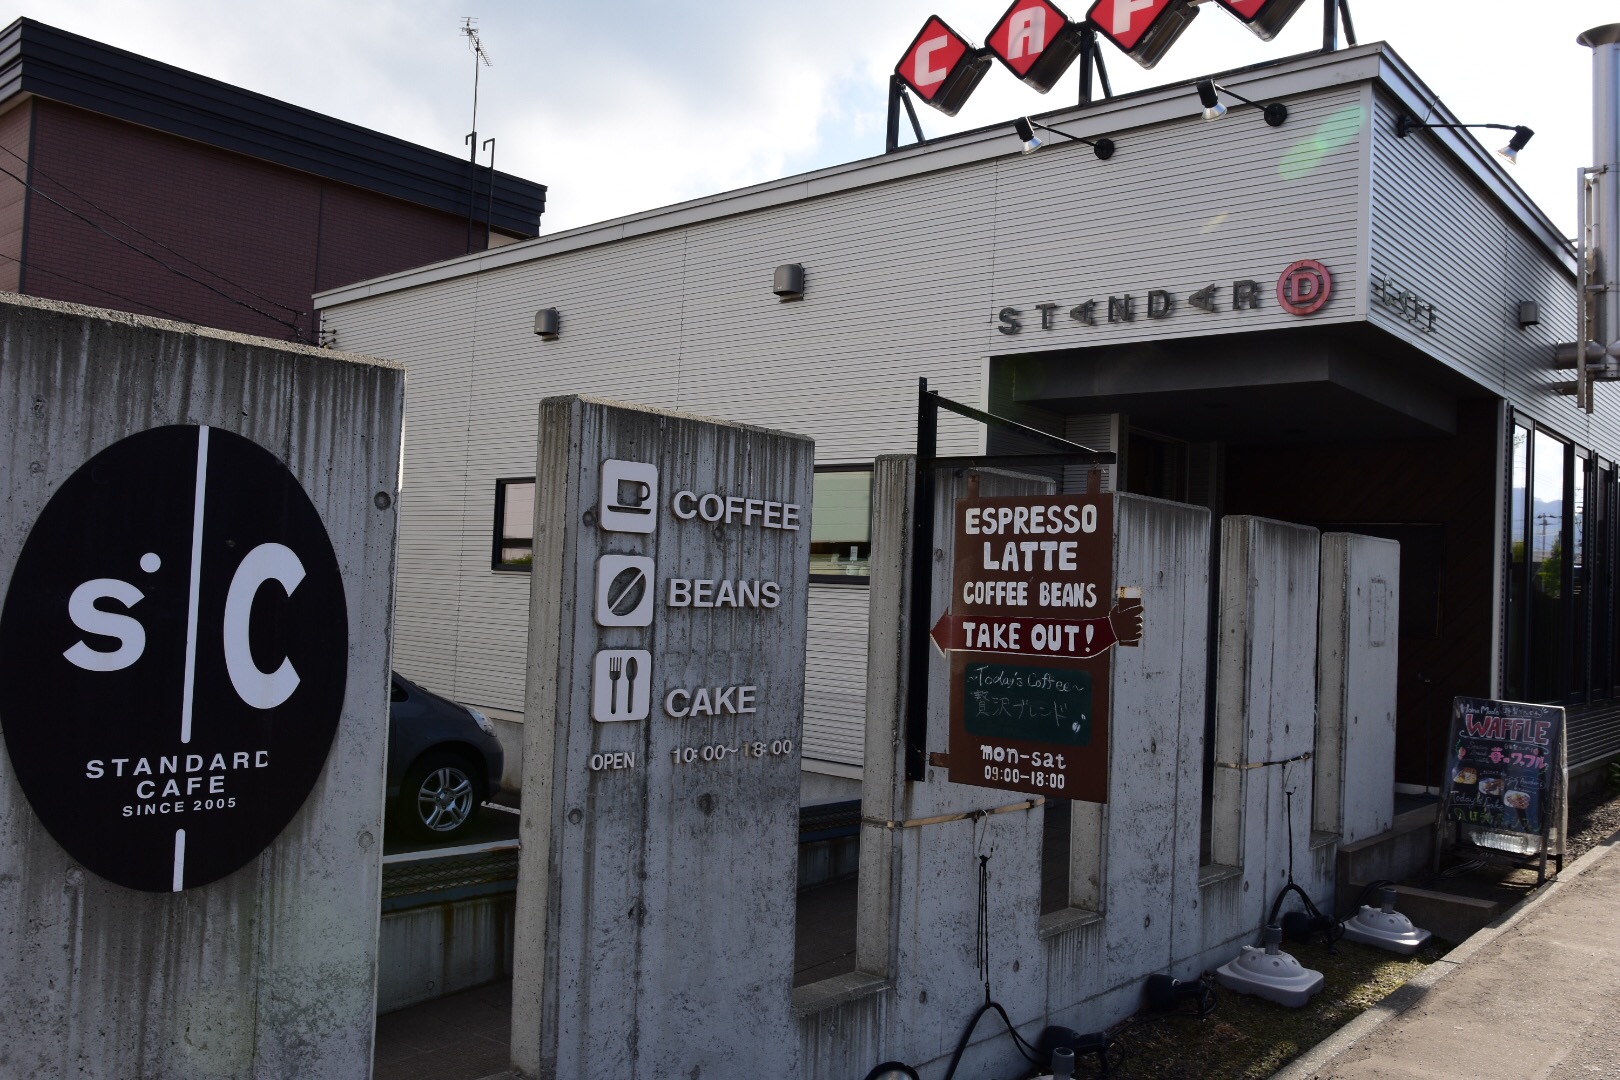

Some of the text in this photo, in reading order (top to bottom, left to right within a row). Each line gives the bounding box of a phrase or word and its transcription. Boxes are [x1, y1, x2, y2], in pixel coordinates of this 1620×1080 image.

[673, 490, 801, 531] COFFEE
[965, 504, 1097, 535] ESPRESSO
[983, 541, 1078, 572] LATTE
[668, 578, 780, 608] BEANS
[963, 581, 1097, 608] COFFEE BEANS
[223, 542, 307, 710] C
[962, 621, 1095, 653] TAKE OUT!
[664, 686, 757, 718] CAKE
[1465, 713, 1551, 746] WAFFLE
[86, 750, 270, 779] STANDARD
[591, 751, 635, 771] OPEN
[980, 744, 1067, 769] mon-sat
[136, 775, 226, 800] CAFE
[122, 797, 237, 818] SINCE 2005
